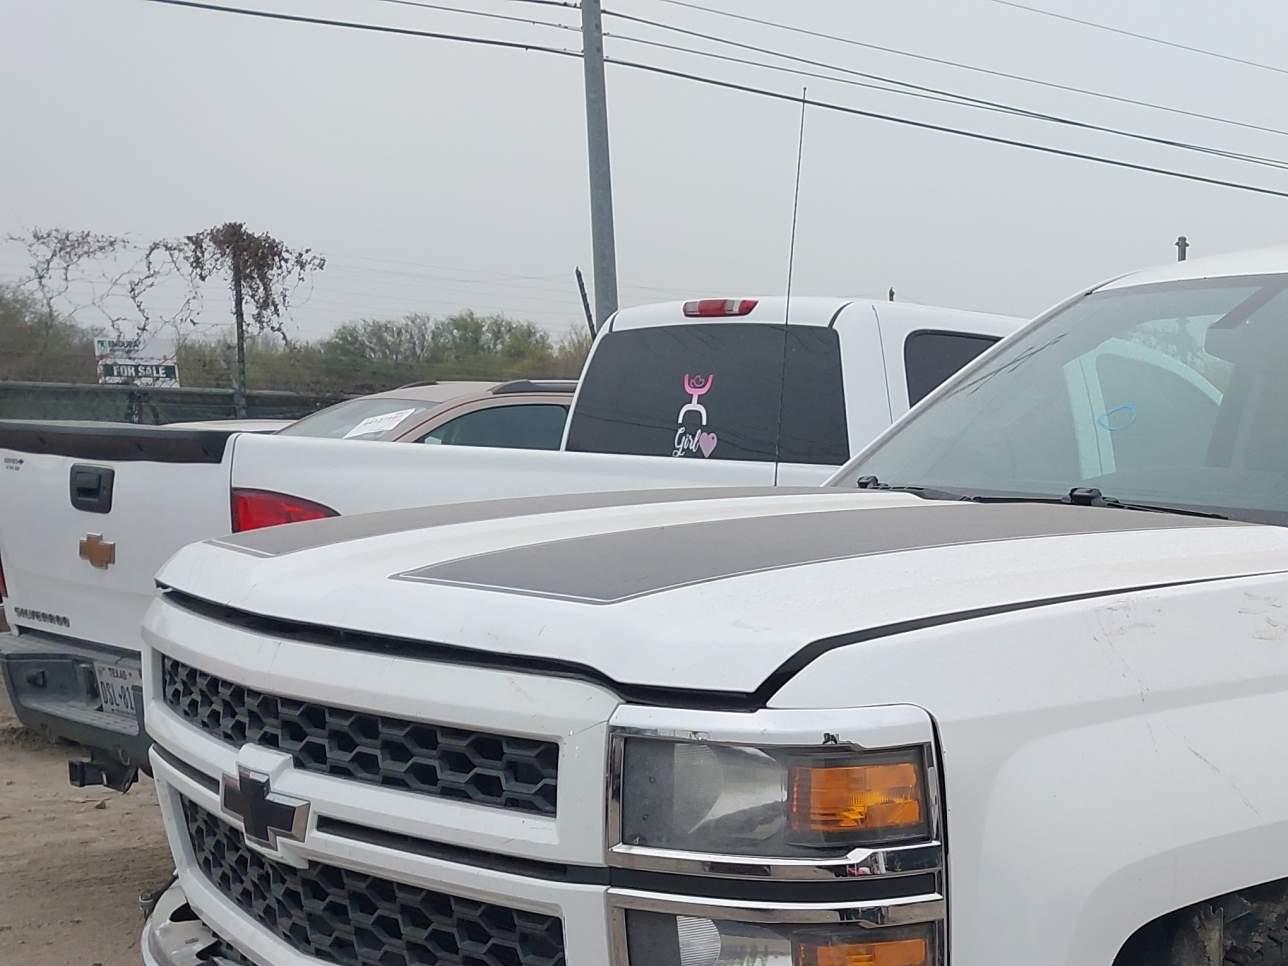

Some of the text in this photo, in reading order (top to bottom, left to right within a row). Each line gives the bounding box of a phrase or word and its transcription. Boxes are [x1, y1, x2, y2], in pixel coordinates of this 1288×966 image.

[113, 365, 167, 378] FOR SALE
[672, 426, 702, 458] Girl
